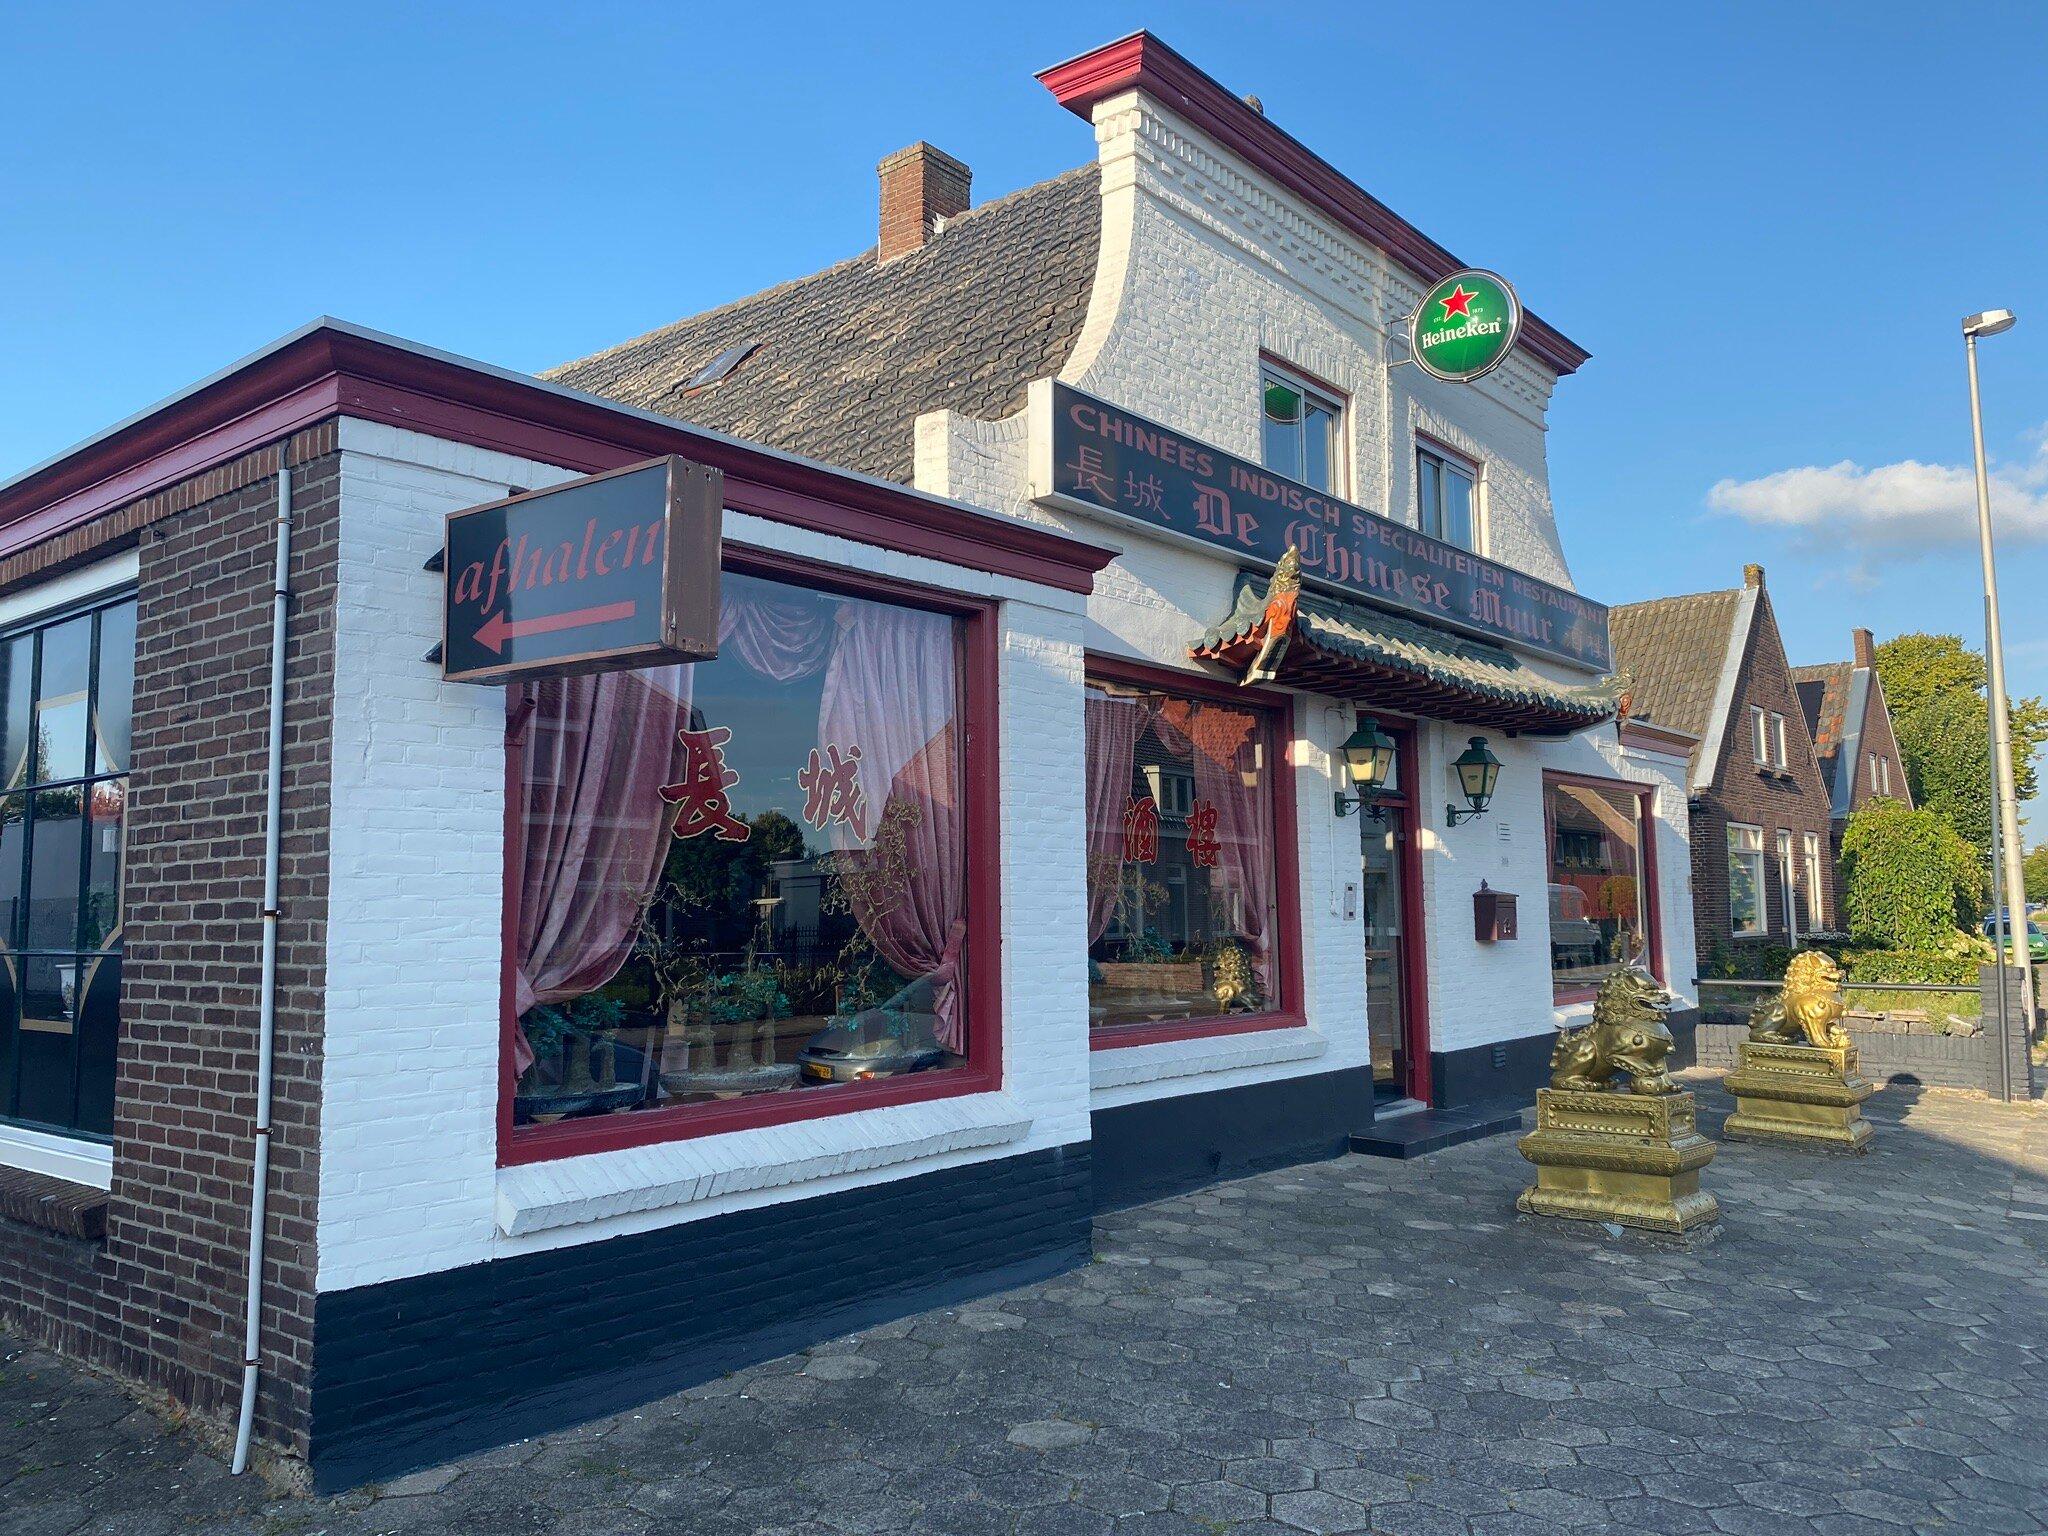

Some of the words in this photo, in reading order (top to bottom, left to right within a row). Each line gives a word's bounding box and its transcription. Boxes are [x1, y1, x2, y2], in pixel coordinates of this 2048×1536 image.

[1422, 321, 1501, 349] Heineken
[1066, 445, 1171, 520] 長城
[1070, 404, 1214, 477] CHINEES
[1230, 466, 1340, 527] INDISCH
[1352, 514, 1504, 588] SPECIALITEITEN
[454, 517, 662, 615] afhalen
[1192, 480, 1260, 547] De
[1284, 520, 1451, 611] Chinese
[1468, 588, 1553, 643] Muur
